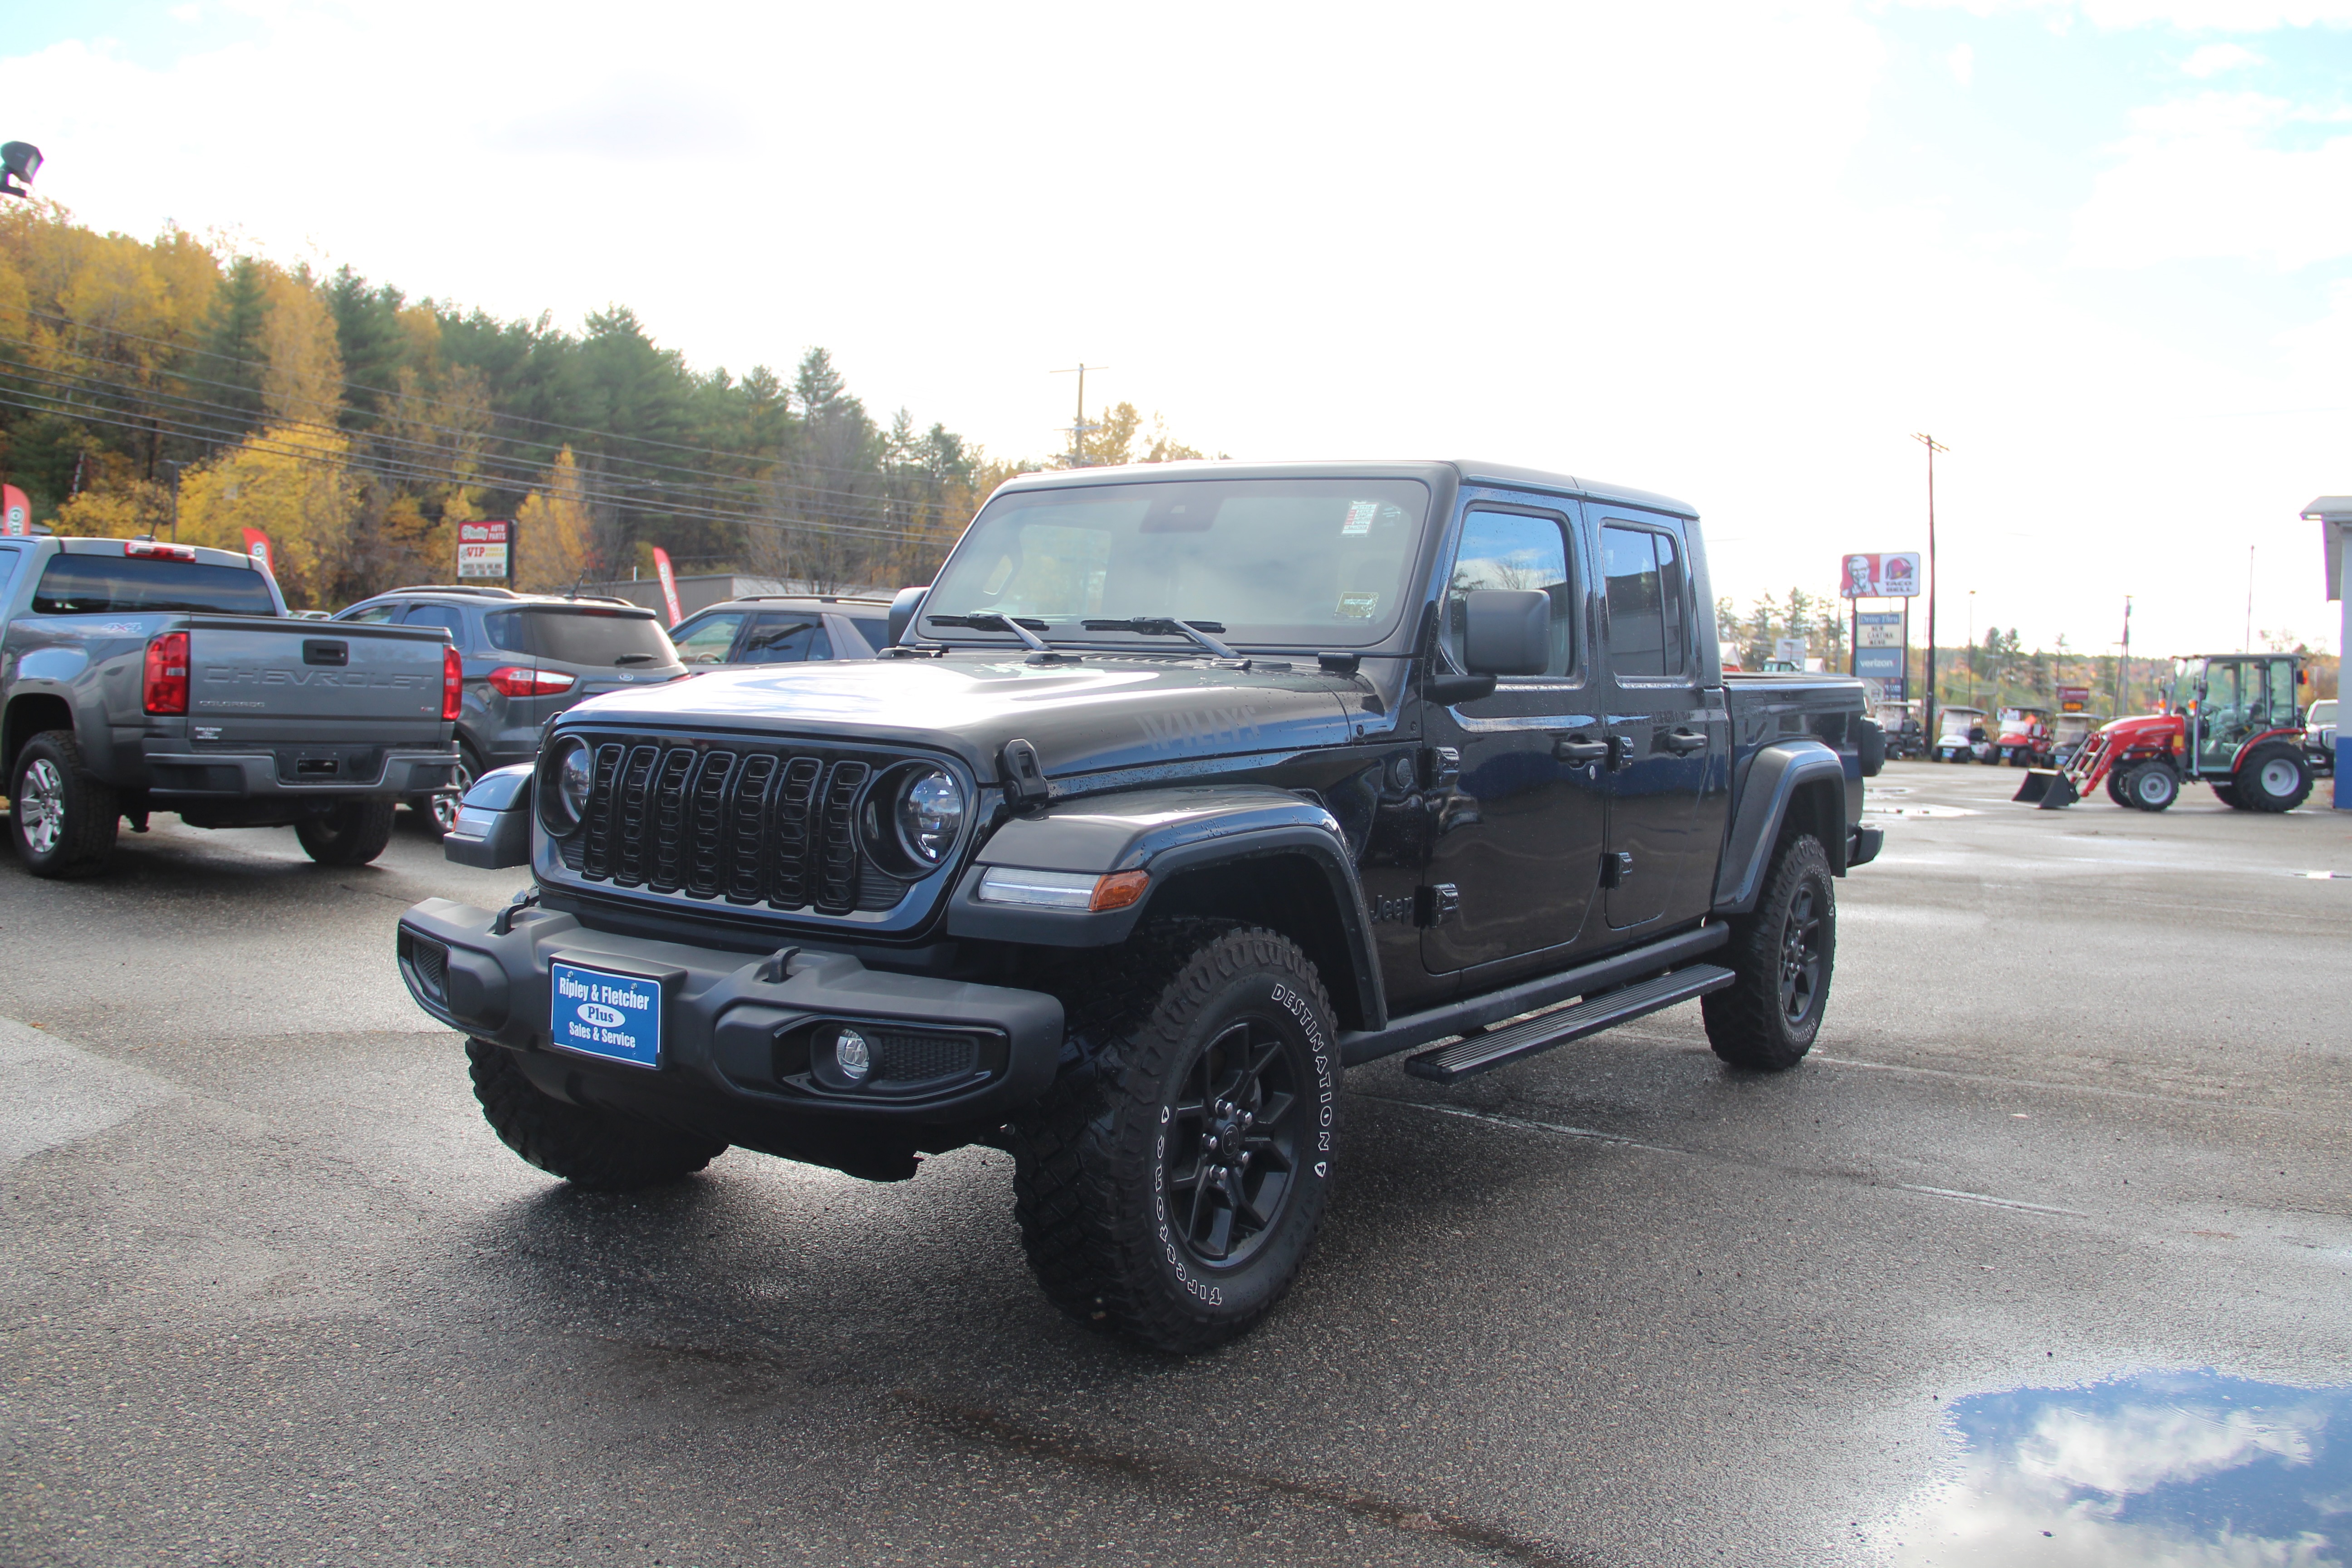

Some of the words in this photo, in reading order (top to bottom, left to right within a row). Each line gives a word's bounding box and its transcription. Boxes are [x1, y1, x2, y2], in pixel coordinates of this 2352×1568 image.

[467, 547, 485, 557] VIP
[1881, 614, 1898, 623] Thru
[1860, 658, 1893, 668] verizon
[204, 666, 433, 689] CHEVROLET
[1134, 706, 1260, 751] WILLYS
[1370, 895, 1414, 924] Jeep
[559, 976, 589, 1002] Ripley
[591, 983, 599, 1002] &
[602, 985, 650, 1010] Fletcher
[588, 1006, 614, 1023] Plus
[569, 1021, 591, 1039] Sales
[593, 1026, 600, 1041] &
[602, 1028, 636, 1049] Service
[1271, 983, 1332, 1151] DESTINATION
